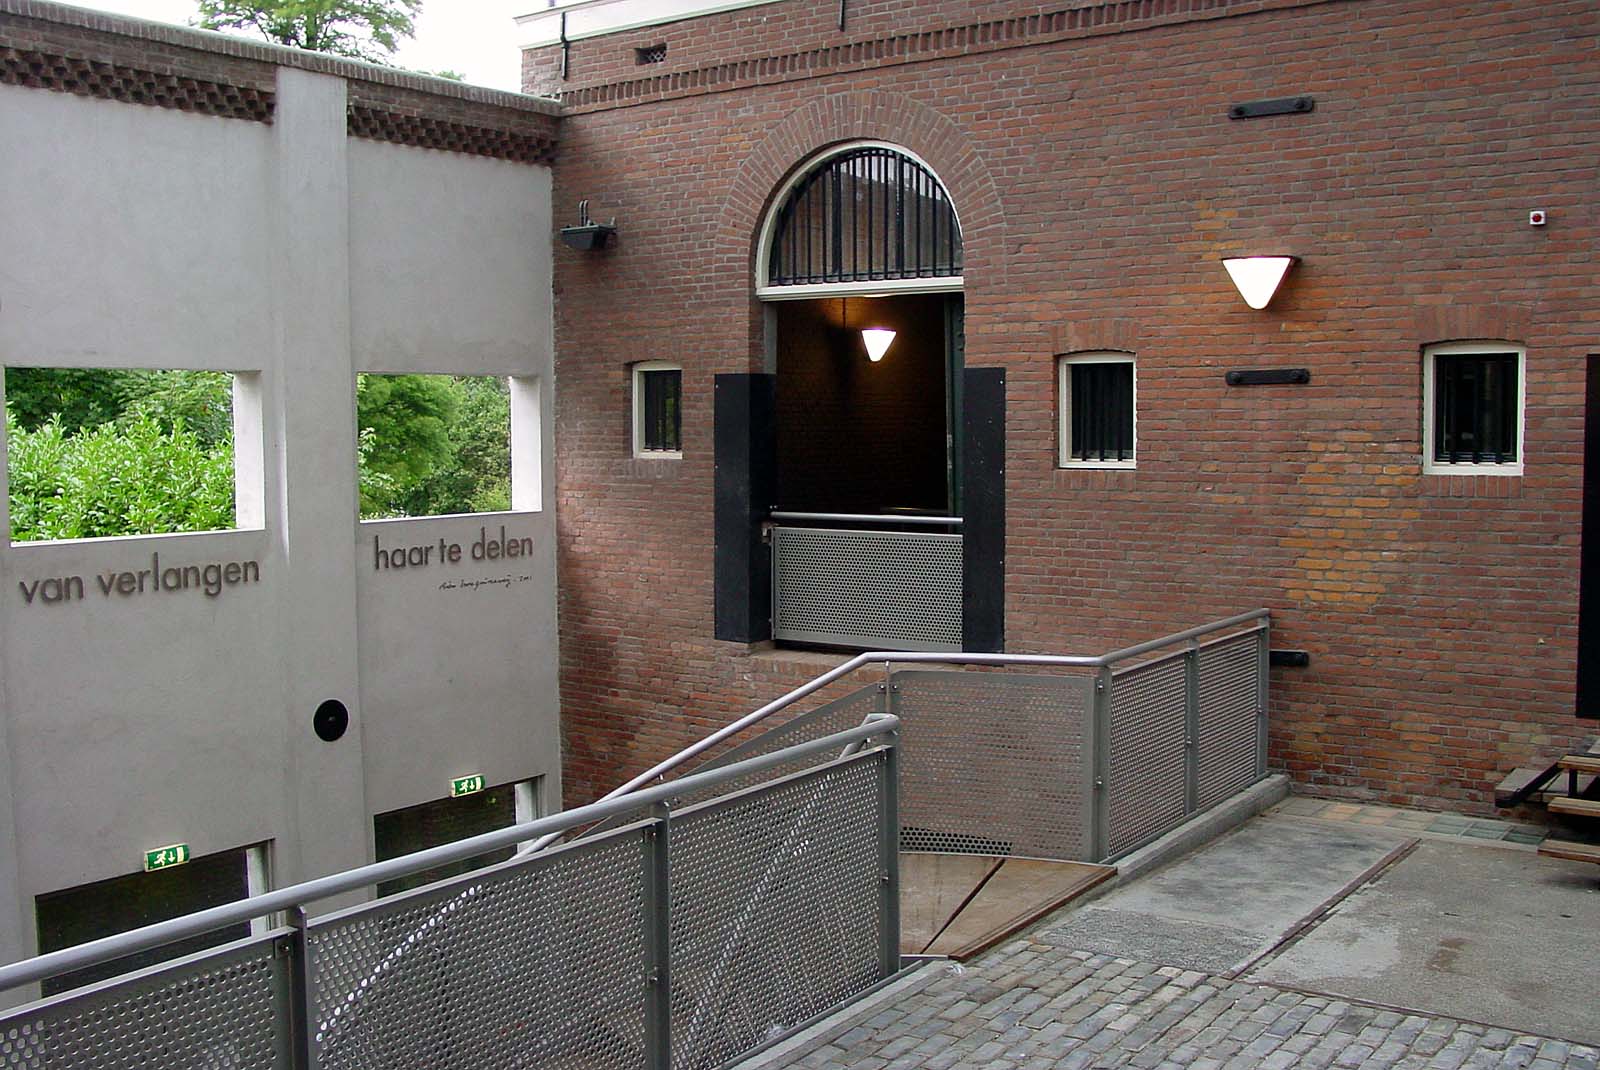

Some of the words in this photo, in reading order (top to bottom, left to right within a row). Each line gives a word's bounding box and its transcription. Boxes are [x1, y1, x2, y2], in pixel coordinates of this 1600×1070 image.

[374, 535, 434, 570] haar
[439, 538, 462, 564] te
[471, 526, 534, 561] delen
[19, 574, 84, 605] van
[97, 551, 261, 597] verlangen
